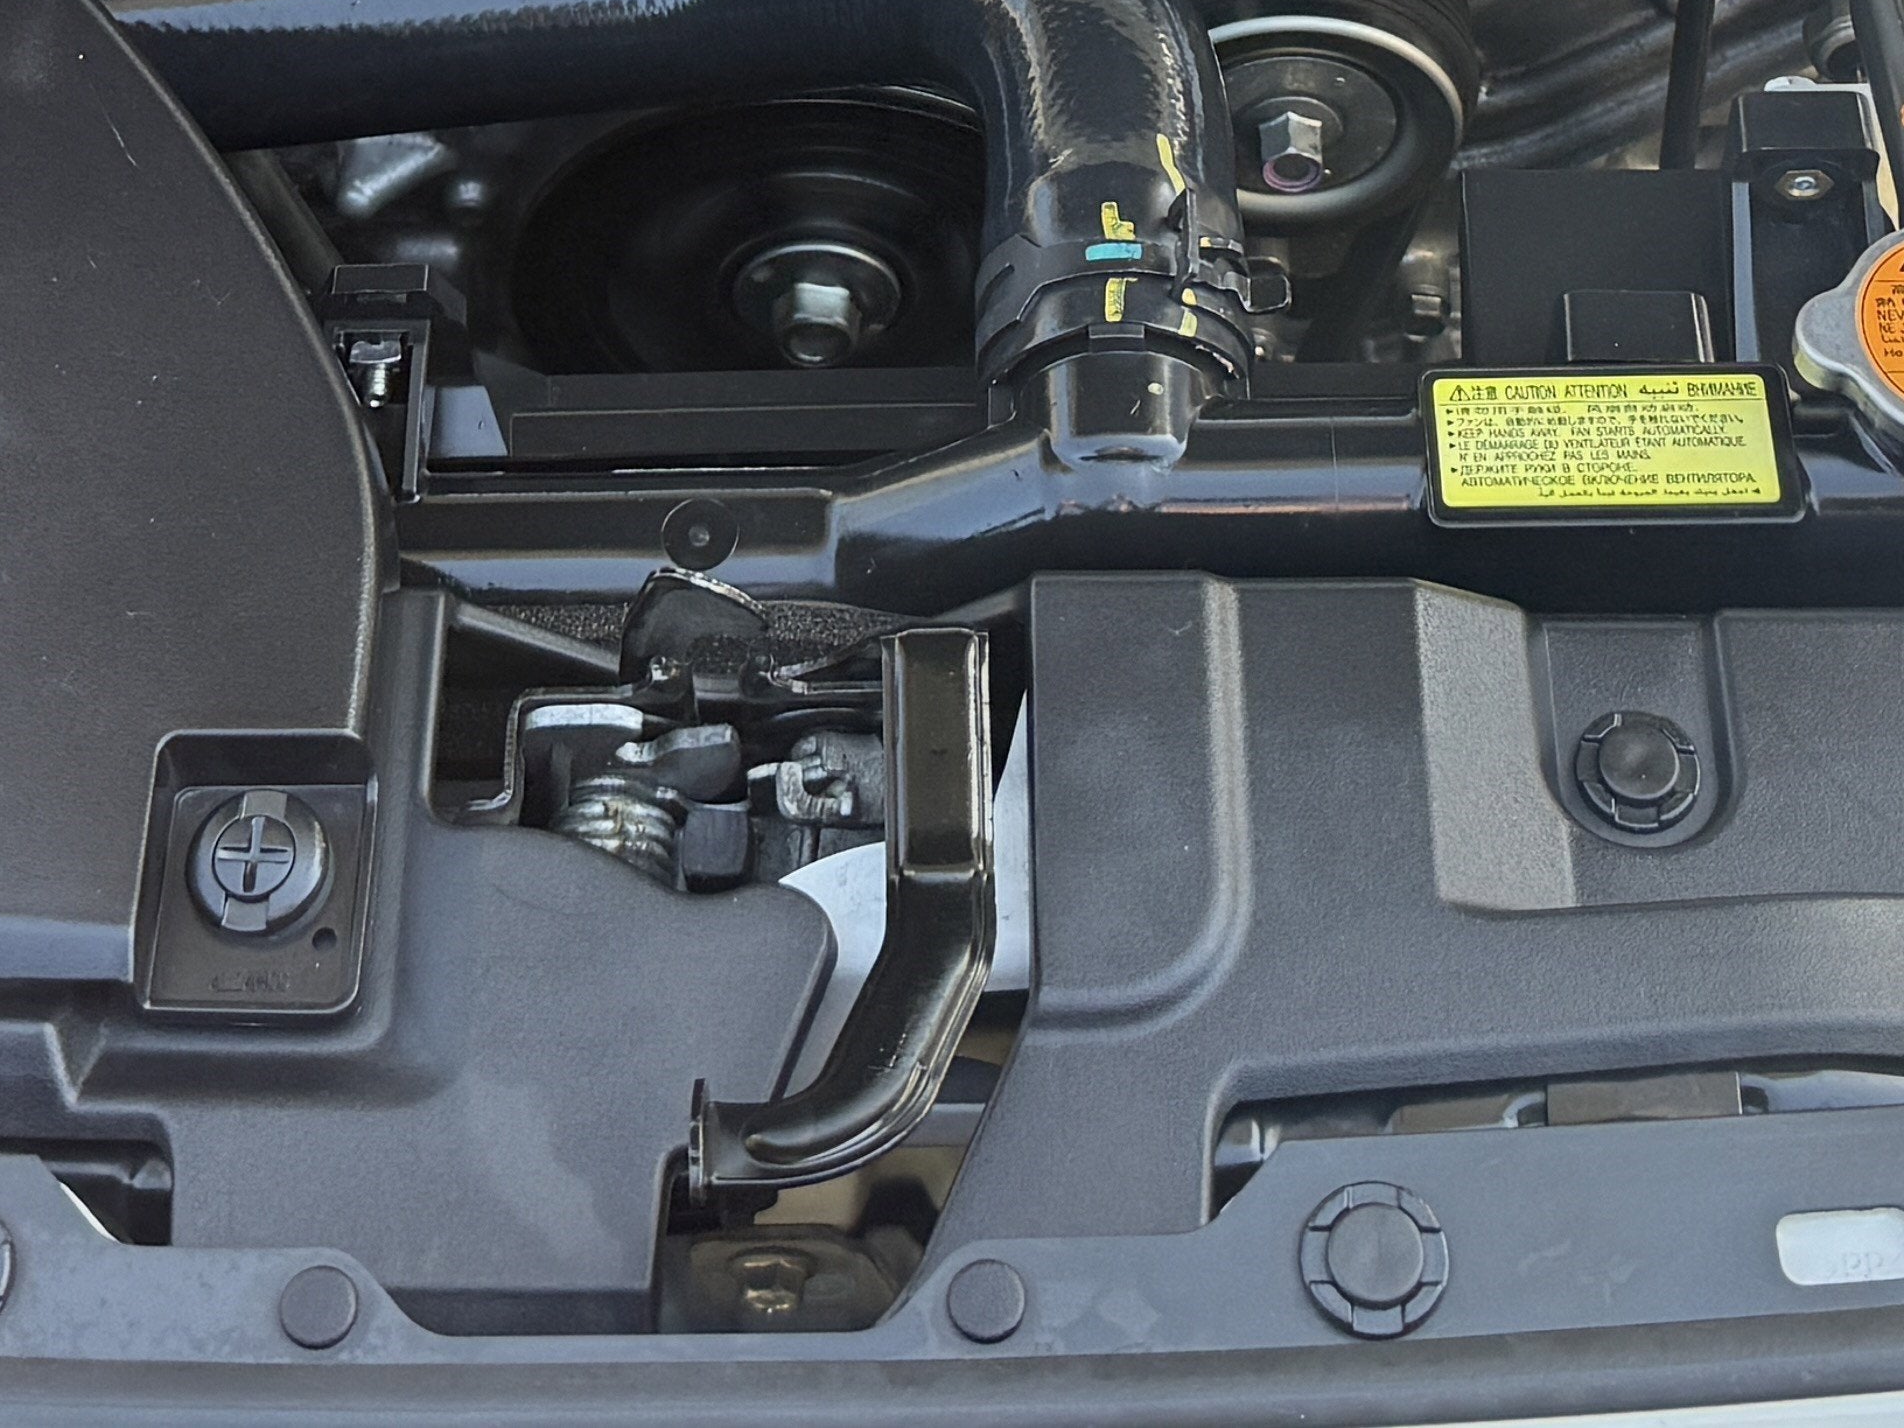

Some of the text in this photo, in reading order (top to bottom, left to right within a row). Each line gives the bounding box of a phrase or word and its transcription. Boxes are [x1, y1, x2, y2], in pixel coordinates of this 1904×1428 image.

[1879, 322, 1895, 333] NE
[1505, 385, 1557, 400] CAUTION
[1564, 384, 1628, 399] ATTENTION
[1686, 381, 1758, 397] ВНИМАНИЕ
[1457, 428, 1483, 438] KEEP
[1489, 428, 1525, 438] HANDS
[1570, 427, 1591, 436] FAN
[1596, 425, 1636, 436] STARTS
[1563, 450, 1583, 460] PAS
[1590, 450, 1609, 460] LES
